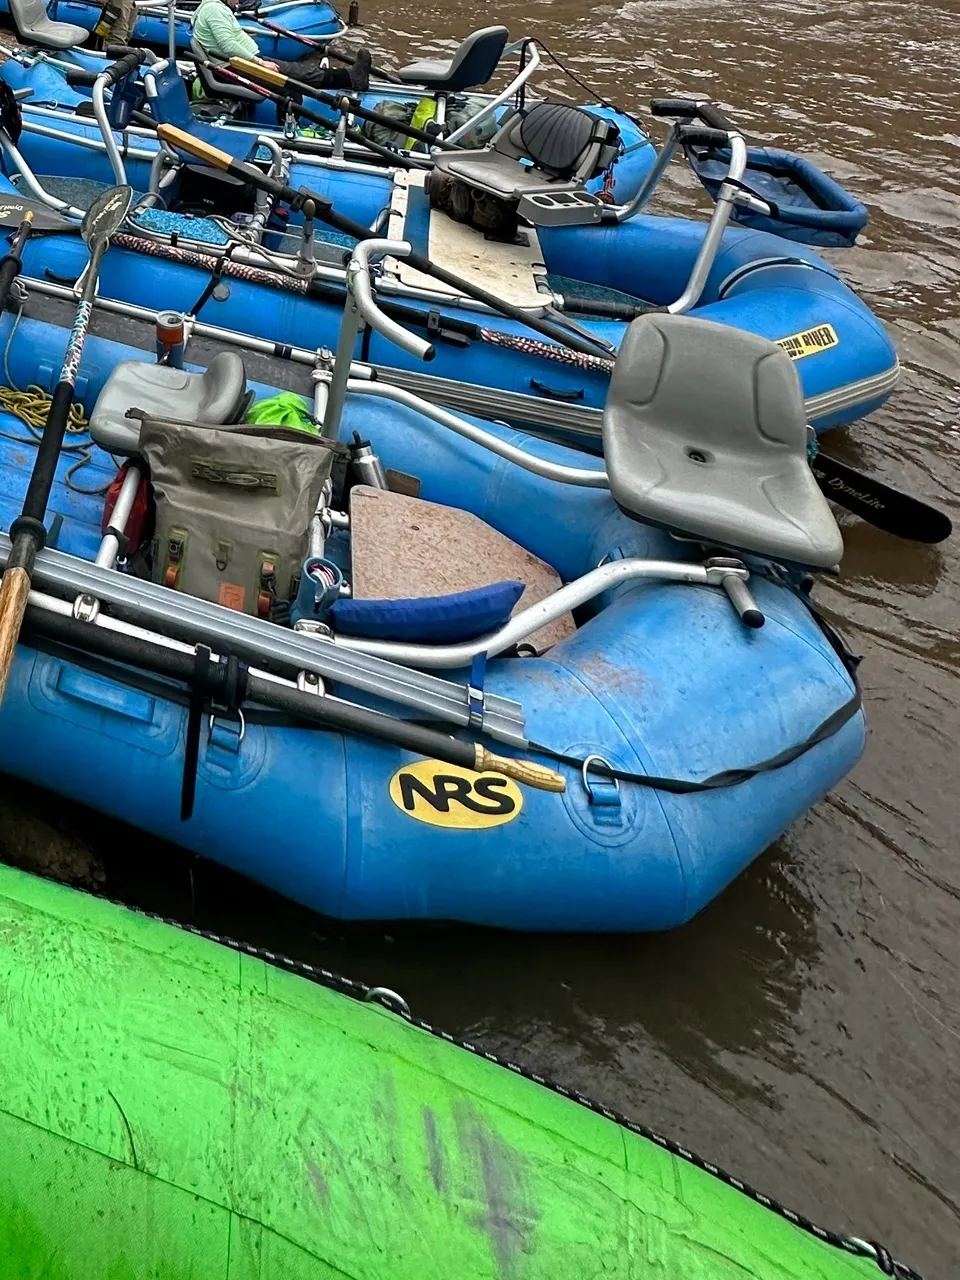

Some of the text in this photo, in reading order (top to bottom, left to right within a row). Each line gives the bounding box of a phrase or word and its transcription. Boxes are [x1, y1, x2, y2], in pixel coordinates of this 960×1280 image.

[801, 326, 836, 347] RIVER
[827, 477, 886, 509] DyneLite
[398, 773, 516, 815] NRS
